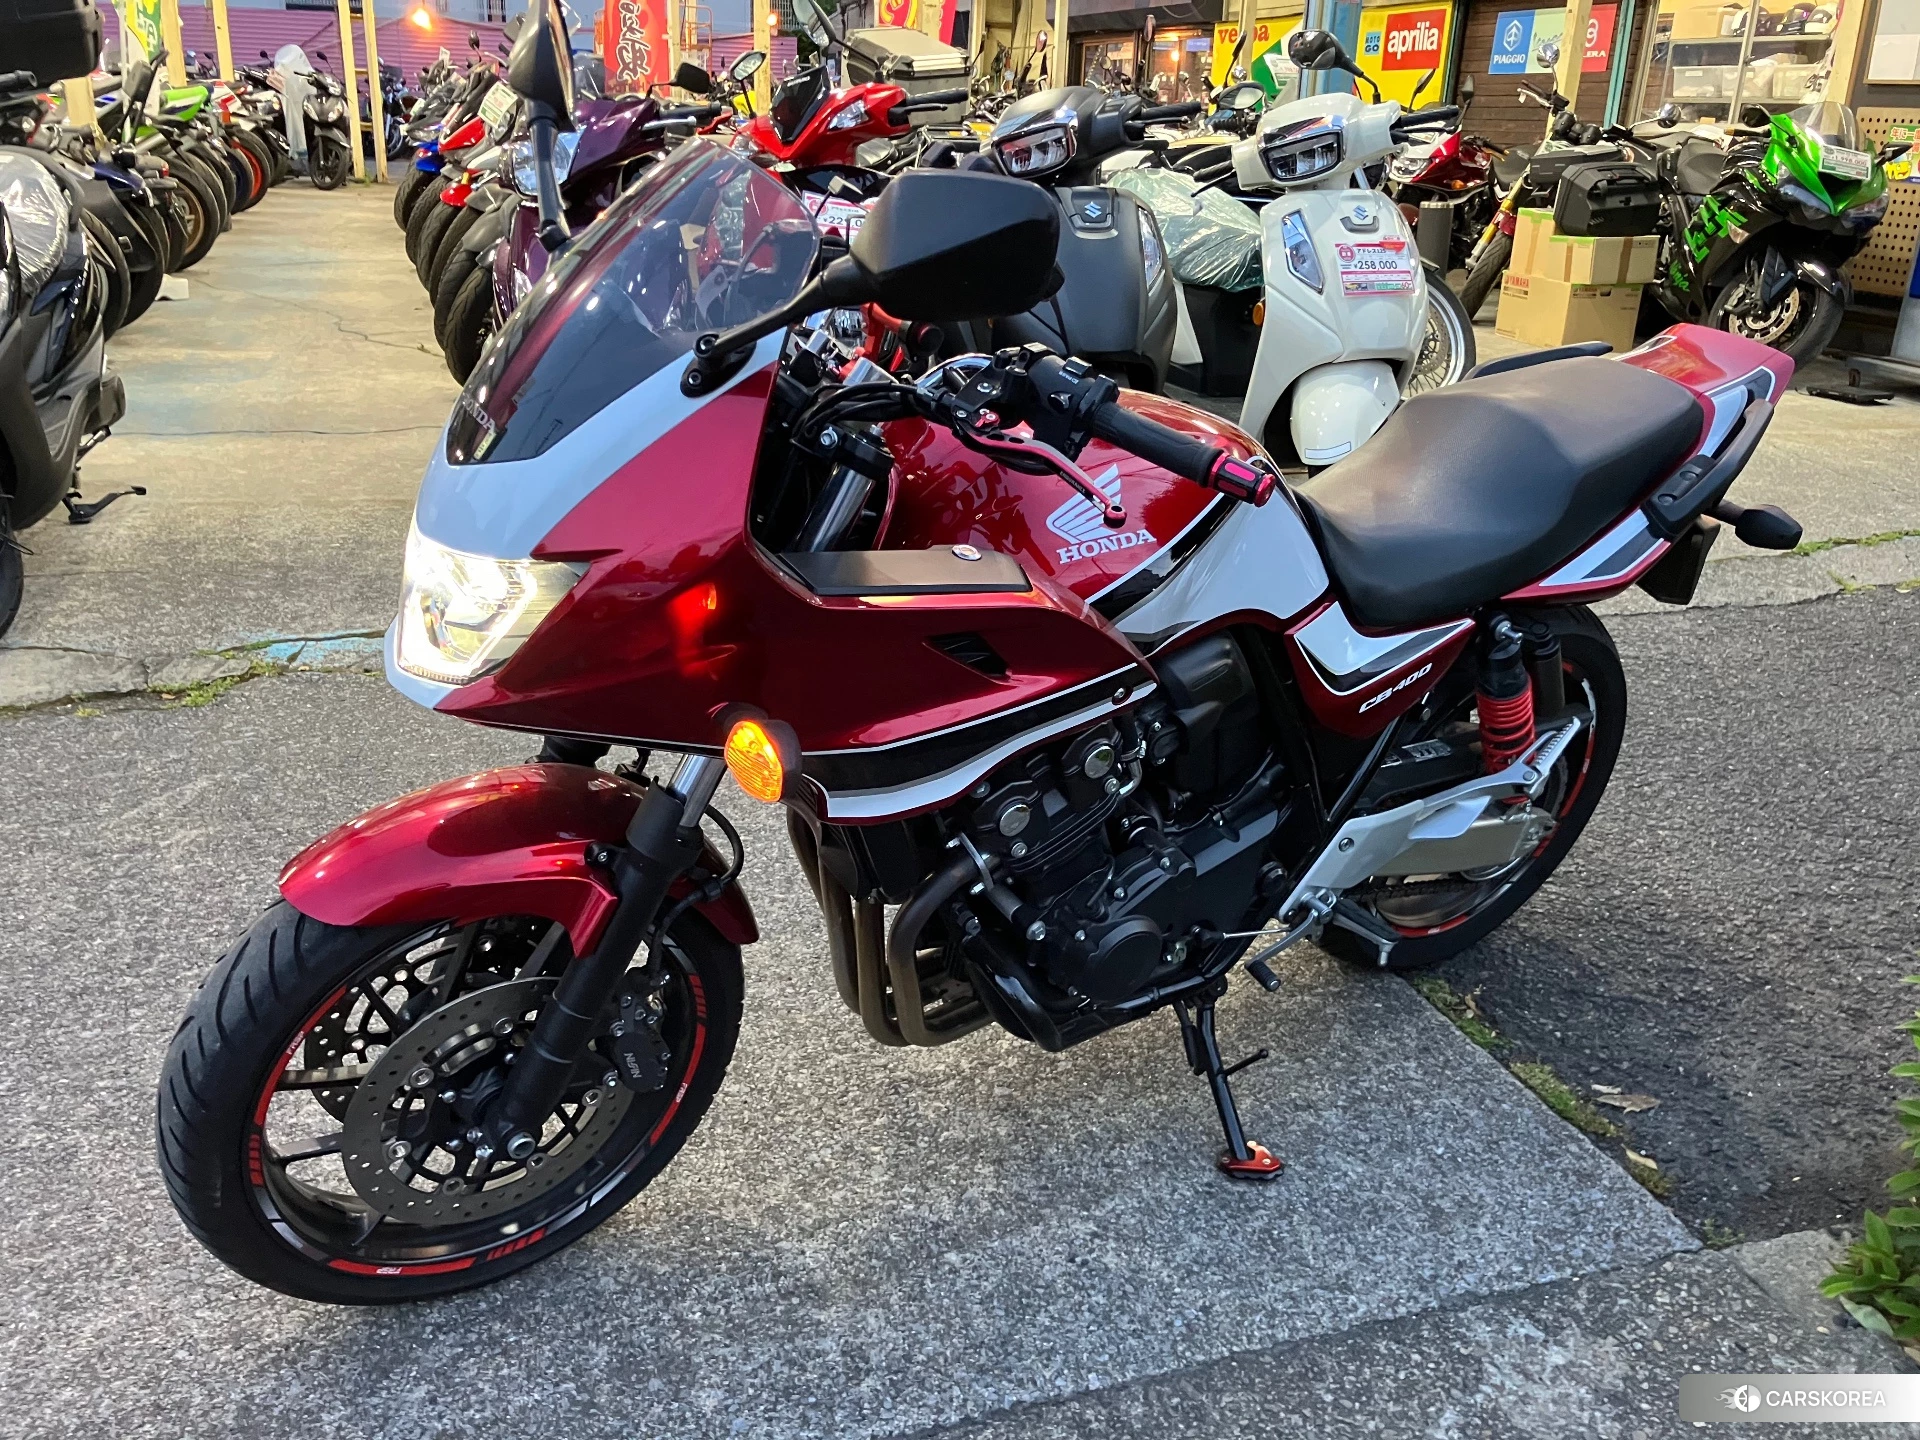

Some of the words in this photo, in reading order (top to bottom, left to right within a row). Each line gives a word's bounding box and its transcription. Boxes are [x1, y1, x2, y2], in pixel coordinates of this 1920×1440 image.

[1218, 25, 1269, 44] vea
[1387, 21, 1439, 60] aprilia
[1364, 45, 1380, 53] GO
[1493, 54, 1526, 64] PIAGGIO
[1354, 260, 1398, 271] ¥258,000
[1055, 528, 1157, 565] HONDA
